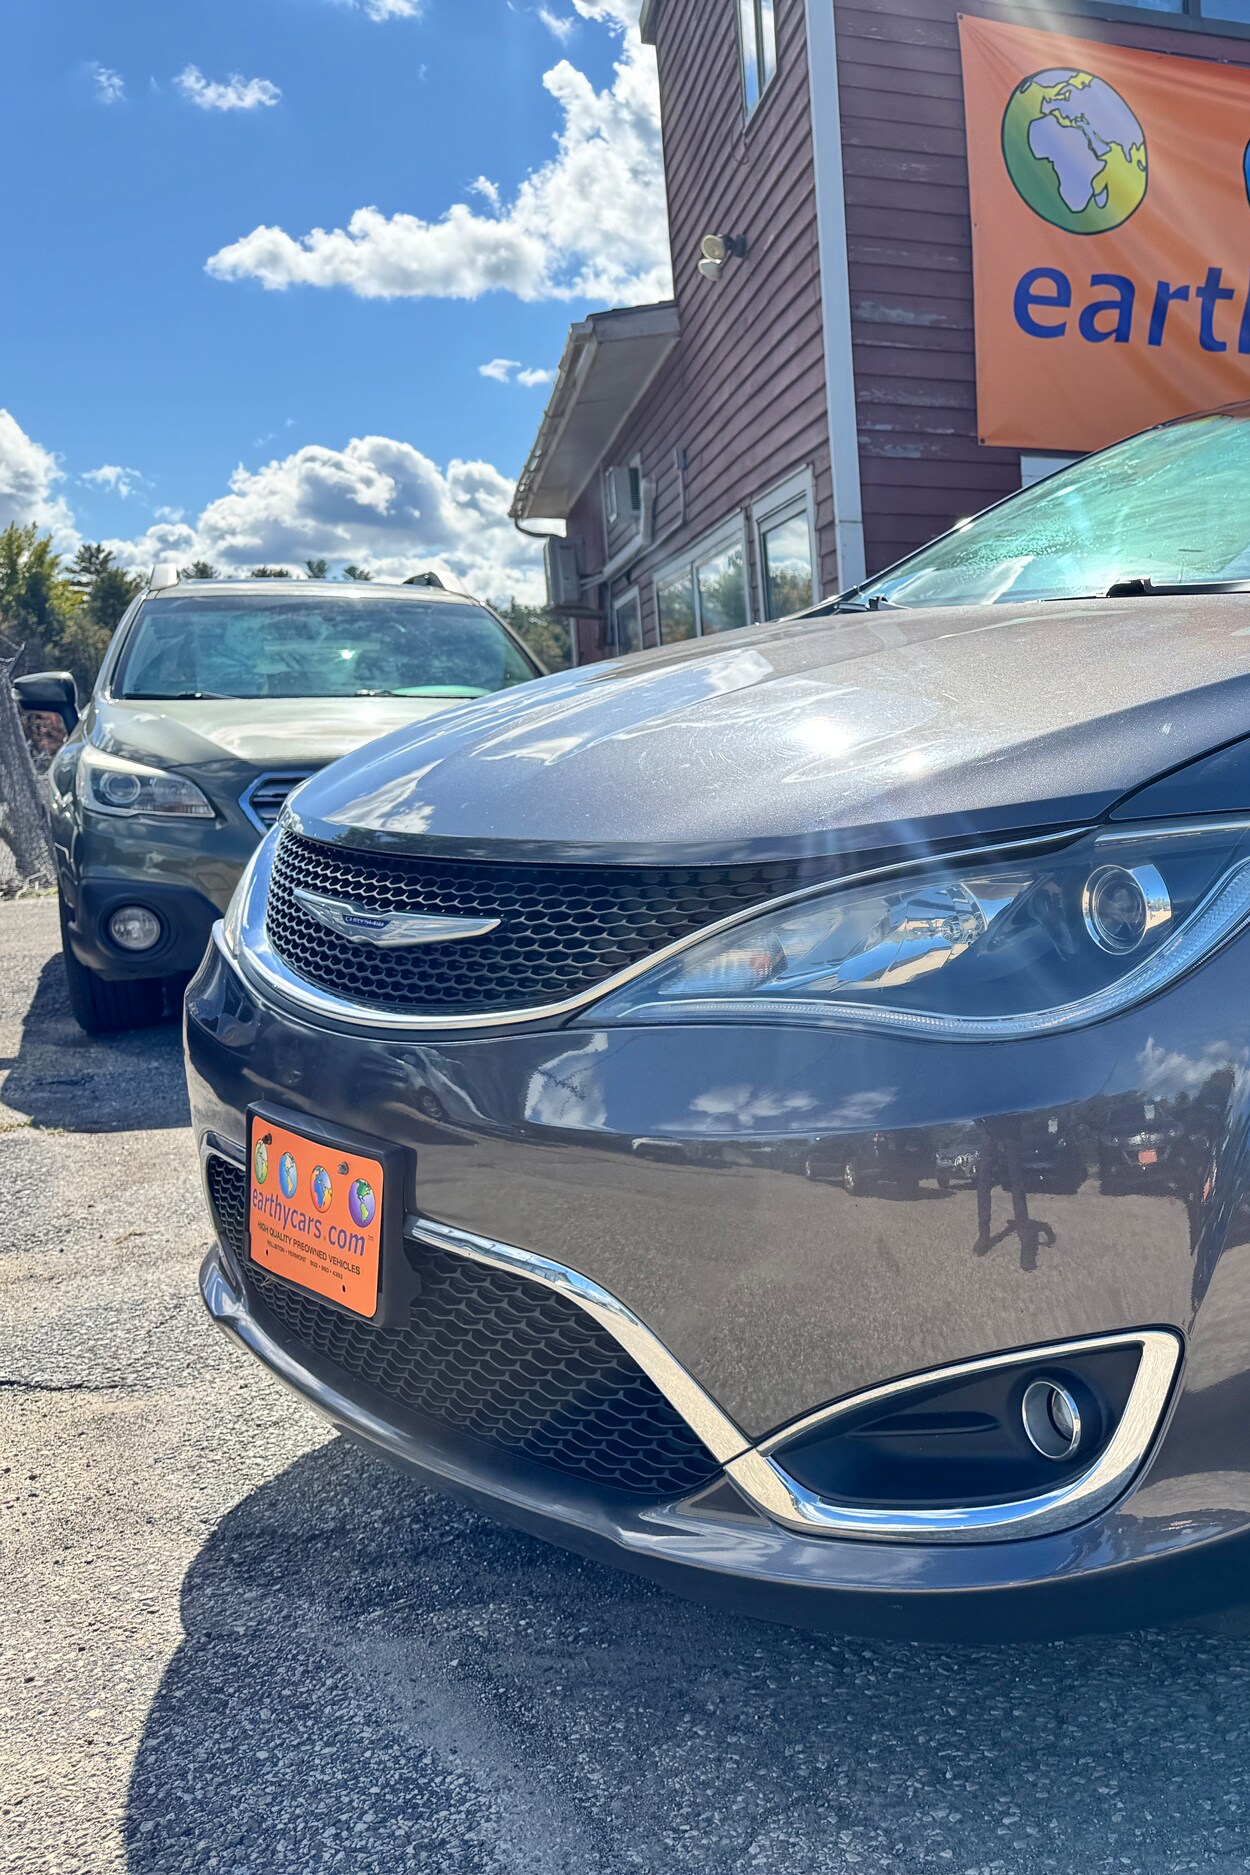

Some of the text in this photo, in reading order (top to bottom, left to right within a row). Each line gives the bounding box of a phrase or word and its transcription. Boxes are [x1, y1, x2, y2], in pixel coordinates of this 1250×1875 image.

[252, 1188, 366, 1257] earthycars.com
[258, 1220, 361, 1275] HIGH QUALITY PREOWNED VEHICLES
